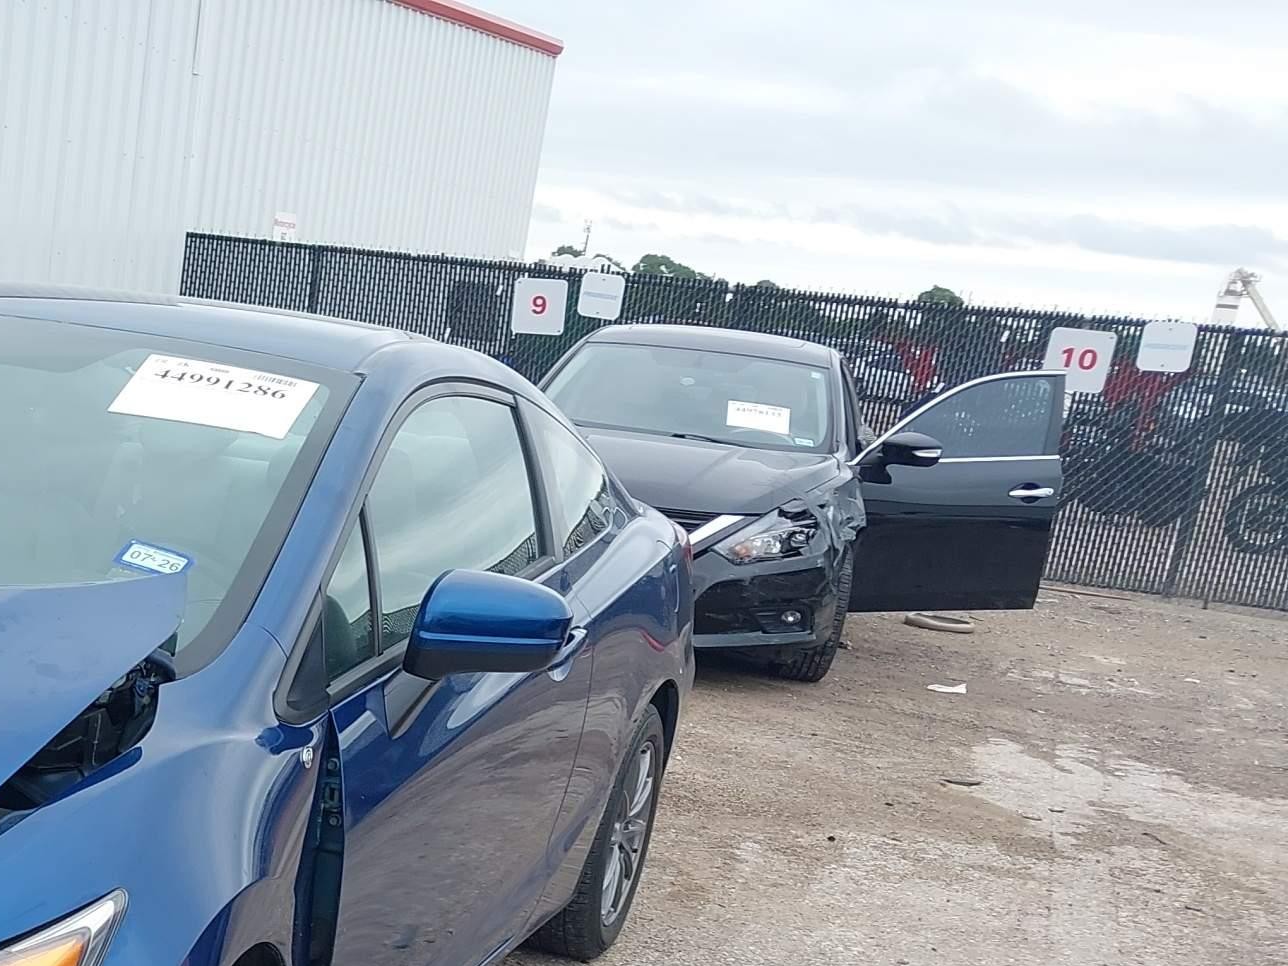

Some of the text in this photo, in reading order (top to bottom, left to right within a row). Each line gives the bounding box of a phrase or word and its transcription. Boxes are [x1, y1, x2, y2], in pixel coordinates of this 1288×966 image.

[531, 295, 547, 315] 9
[1061, 347, 1098, 371] 10
[154, 368, 288, 400] 44991286
